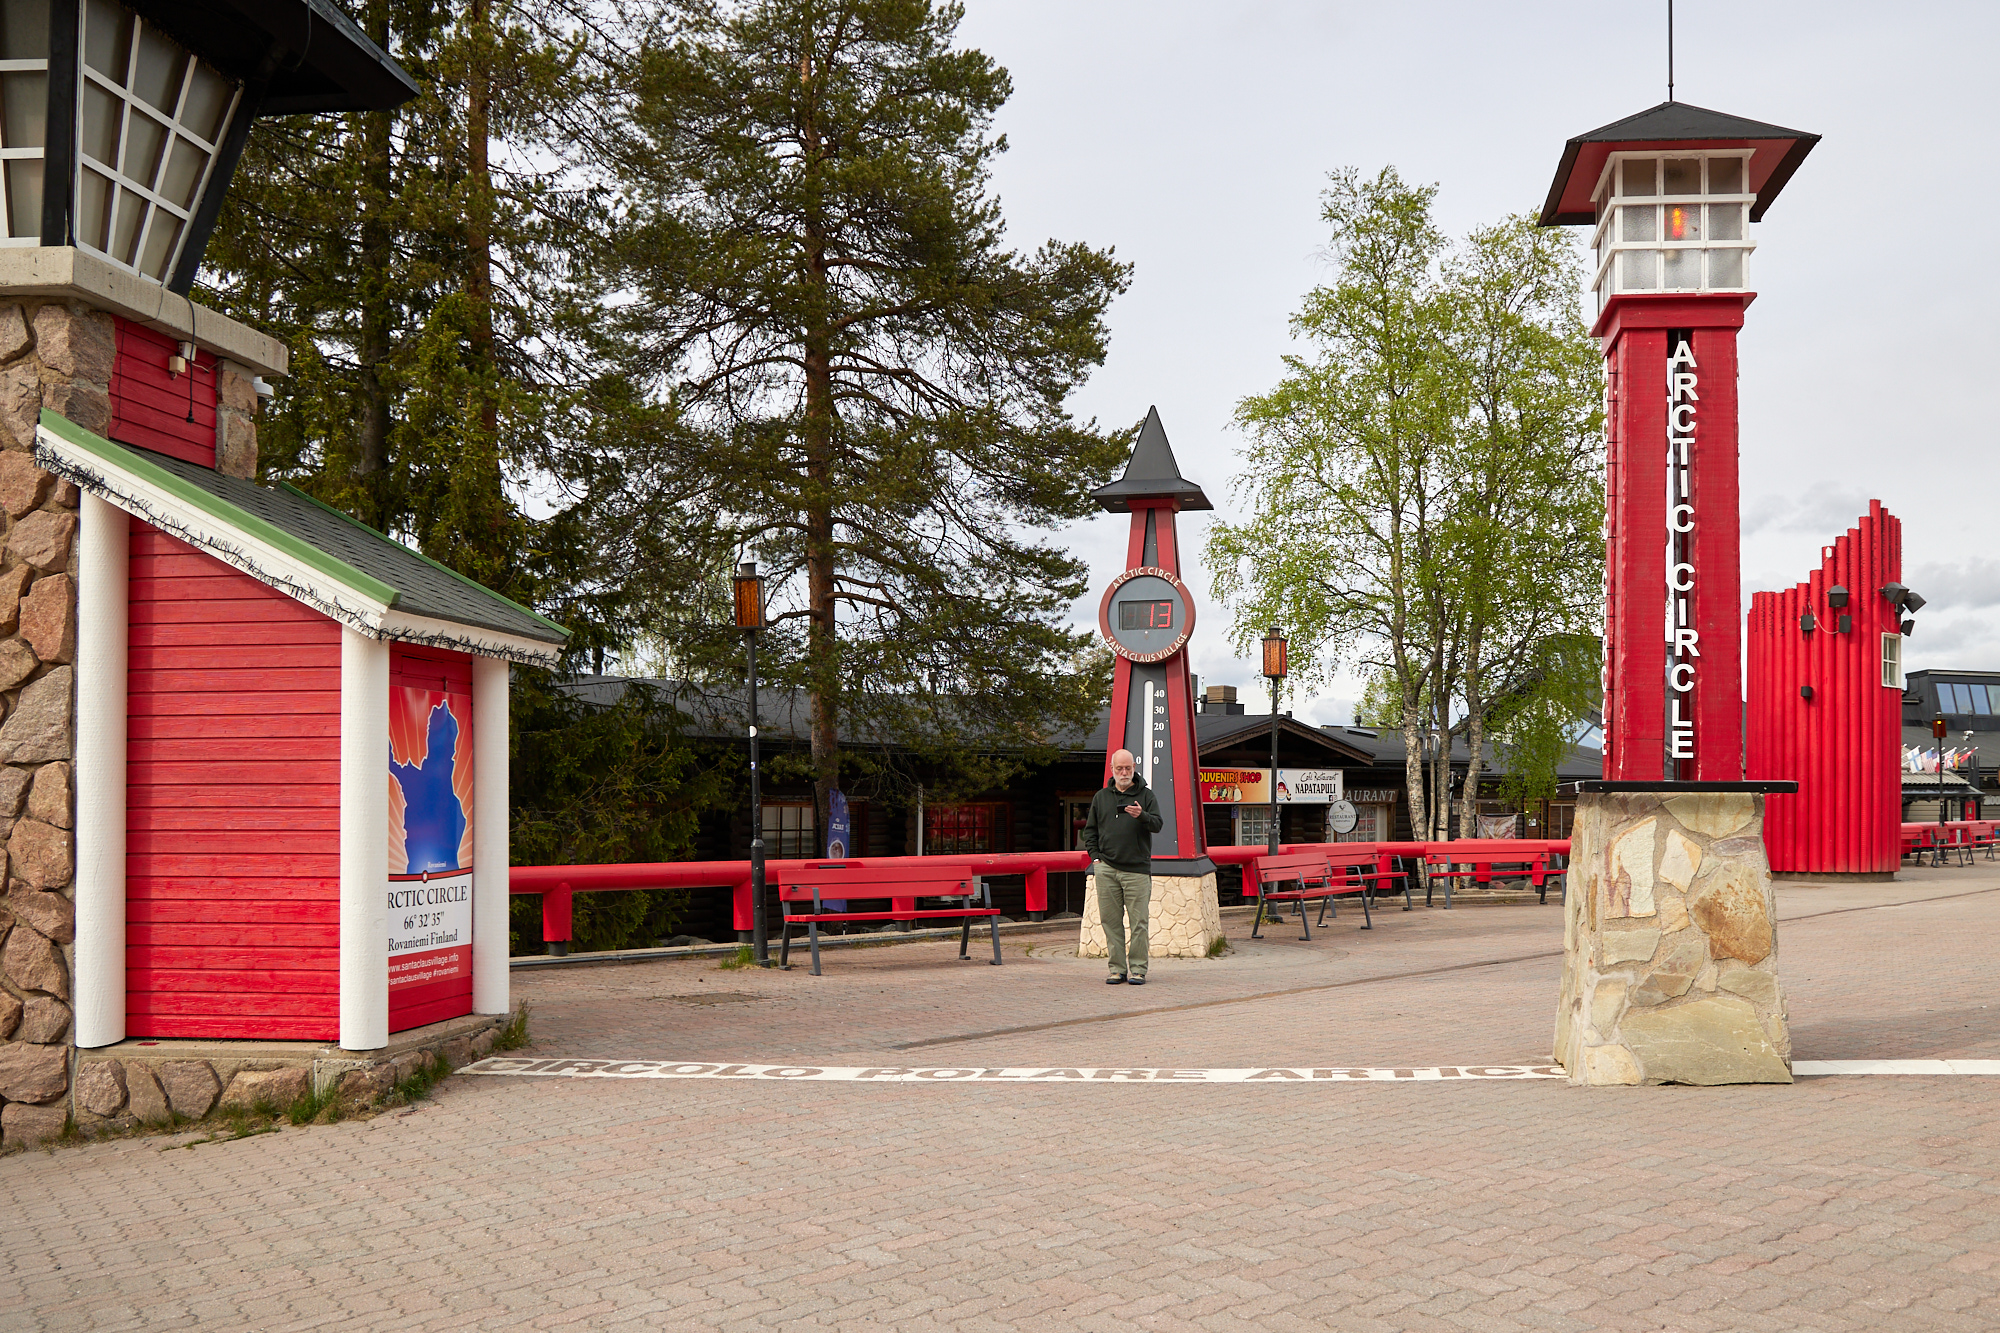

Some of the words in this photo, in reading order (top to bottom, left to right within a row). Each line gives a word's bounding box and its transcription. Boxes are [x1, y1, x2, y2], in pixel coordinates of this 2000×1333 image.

[1672, 340, 1699, 533] ARCTIC
[1112, 567, 1145, 589] ARCTIC
[1147, 567, 1181, 587] CIRCLE
[1149, 603, 1172, 628] 13
[1106, 636, 1128, 659] SANTA
[1128, 652, 1156, 663] CLAUS
[1156, 632, 1188, 660] VILLAGE
[1670, 563, 1700, 759] CIRCLE
[1153, 689, 1165, 698] 40
[1153, 706, 1165, 714] 30
[1153, 722, 1165, 731] 20
[1153, 740, 1164, 748] 10
[1153, 756, 1160, 765] 0
[1199, 771, 1239, 784] OUVENIRS
[1239, 771, 1262, 784] SHOP
[1295, 783, 1336, 794] NAPATAPULI
[1343, 790, 1396, 802] AURANT
[388, 889, 425, 909] RCTIC
[427, 885, 467, 904] CIRCLE
[403, 914, 417, 930] 66°
[388, 934, 429, 952] Rovaniemi
[430, 928, 458, 945] Finland
[388, 971, 432, 985] santaclausvillage
[471, 1059, 824, 1078] CIRCOLO
[854, 1068, 1207, 1079] POLARE
